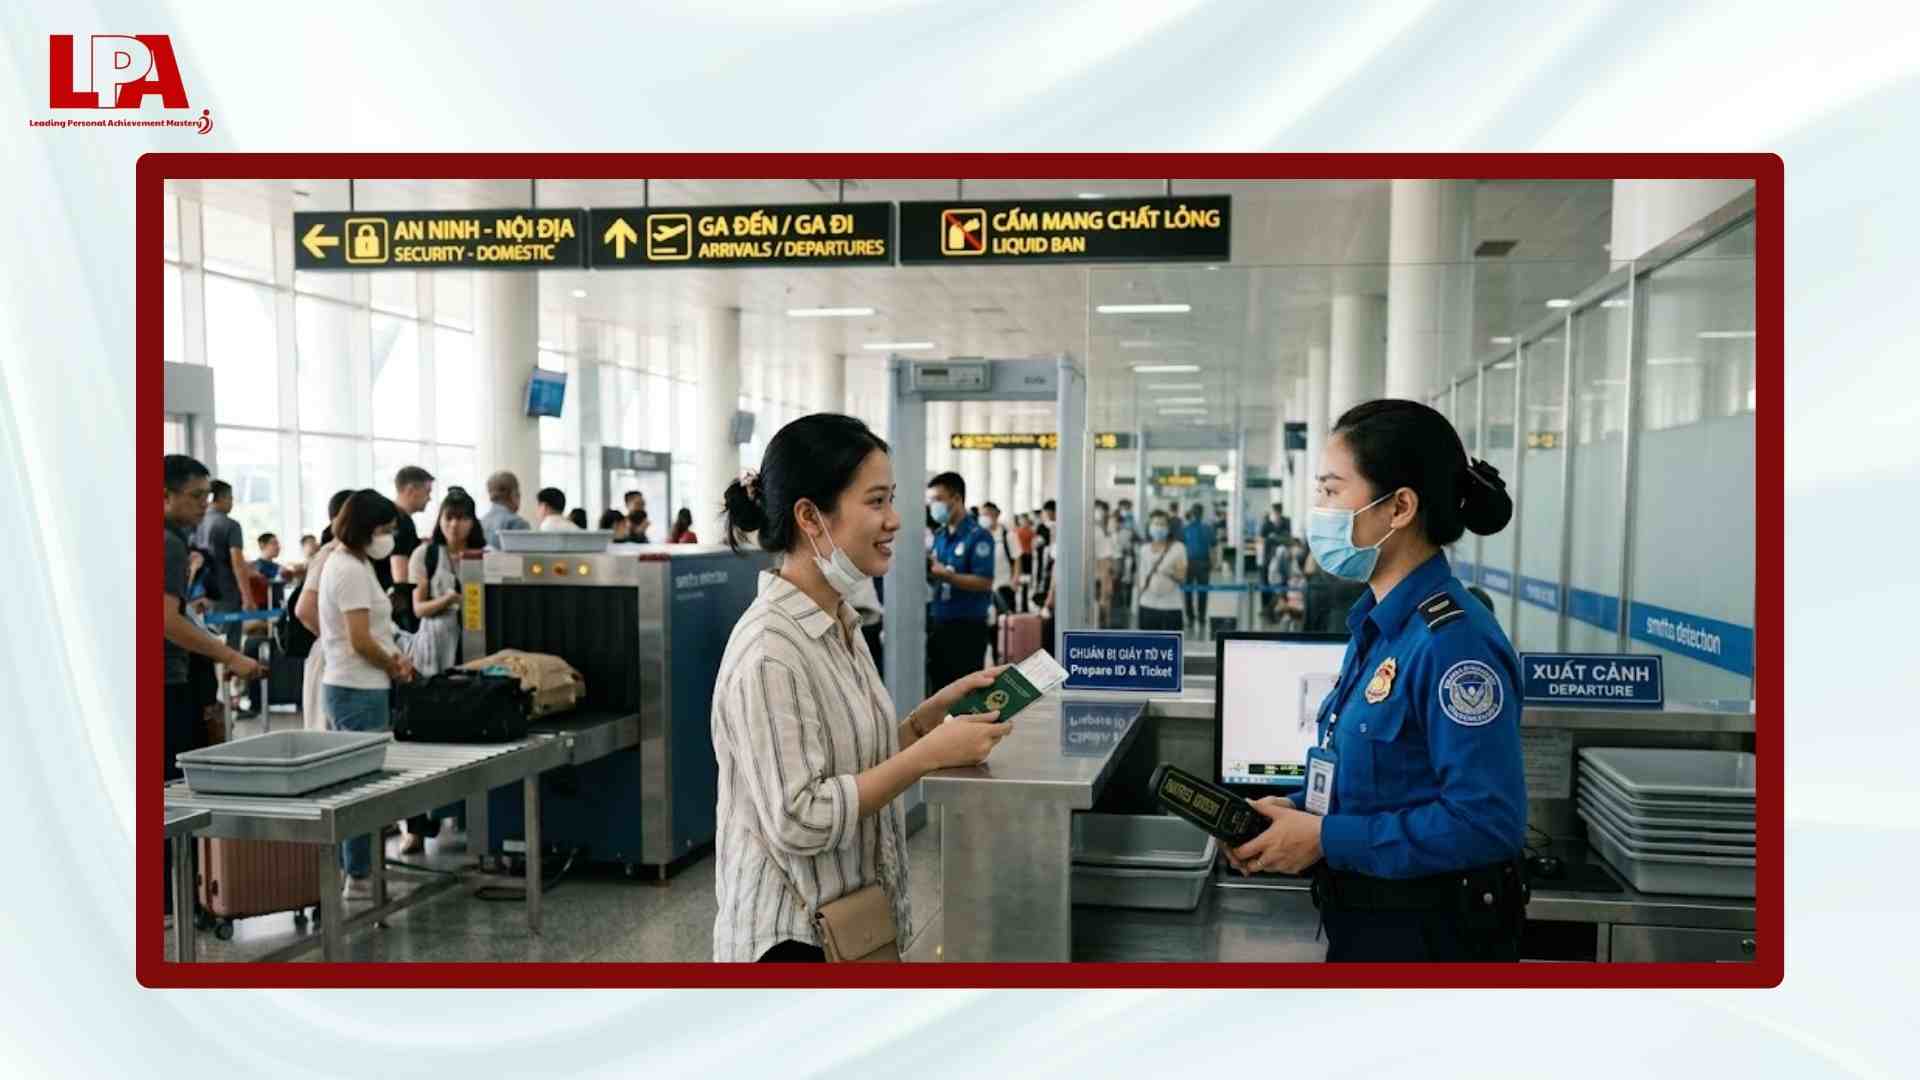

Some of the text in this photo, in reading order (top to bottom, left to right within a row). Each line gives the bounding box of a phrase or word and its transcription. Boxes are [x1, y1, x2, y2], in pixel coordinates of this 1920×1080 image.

[698, 209, 854, 236] GA ĐẾN / GA ĐI
[992, 204, 1221, 232] CẤM MANG CHẤT LỎNG
[394, 220, 424, 240] AN
[428, 219, 480, 240] NINH
[496, 215, 534, 242] NỘI
[536, 218, 576, 243] ĐỊA
[394, 245, 465, 262] SECURITY
[476, 244, 556, 261] DOMESTIC
[698, 239, 885, 258] ARRIVALS / DEPARTURES
[992, 236, 1086, 256] LIQUID BAN
[1071, 664, 1173, 678] Prepare ID & Ticket
[1549, 683, 1634, 697] DEPARTURE
